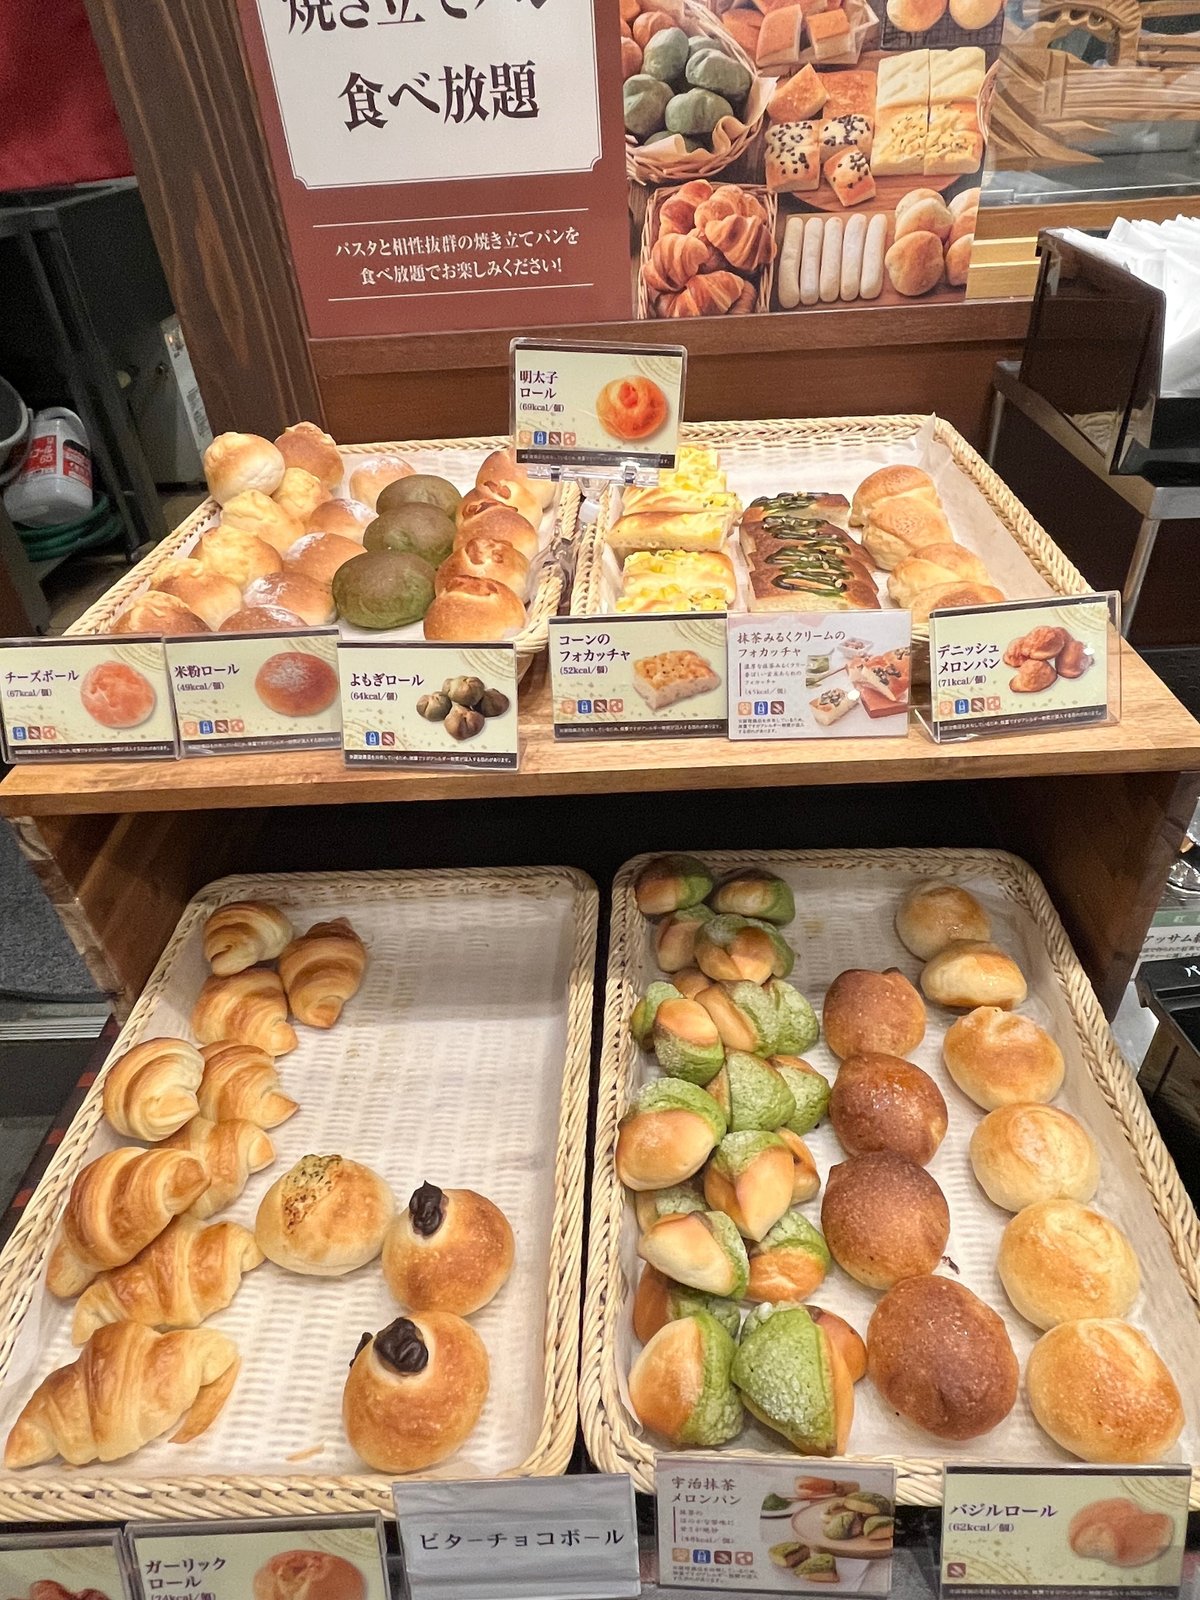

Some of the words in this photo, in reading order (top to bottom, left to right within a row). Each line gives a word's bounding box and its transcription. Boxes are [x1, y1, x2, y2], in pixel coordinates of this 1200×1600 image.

[338, 60, 540, 132] 食べ放題
[335, 226, 580, 257] パスタと相性抜群の焼き立てパンを
[519, 370, 559, 385] 明太子
[519, 387, 557, 400] ロール
[559, 633, 611, 646] コーンの
[736, 630, 846, 644] 抹茶みるくクリームの
[559, 648, 631, 663] フォカッチャ
[737, 646, 802, 659] フォカッチャ
[937, 642, 1000, 659] デニッシュ
[174, 664, 240, 678] 米粉ロール
[938, 657, 1001, 675] メロンパン
[4, 670, 80, 684] チーズボール
[349, 672, 425, 687] よもぎロール
[671, 1476, 736, 1490] 宇治抹茶
[671, 1491, 742, 1505] メロンパン
[949, 1503, 1058, 1518] バジルロール
[420, 1529, 625, 1550] ビターチョコボール
[145, 1556, 227, 1575] ガーリック
[149, 1575, 202, 1590] ロール
